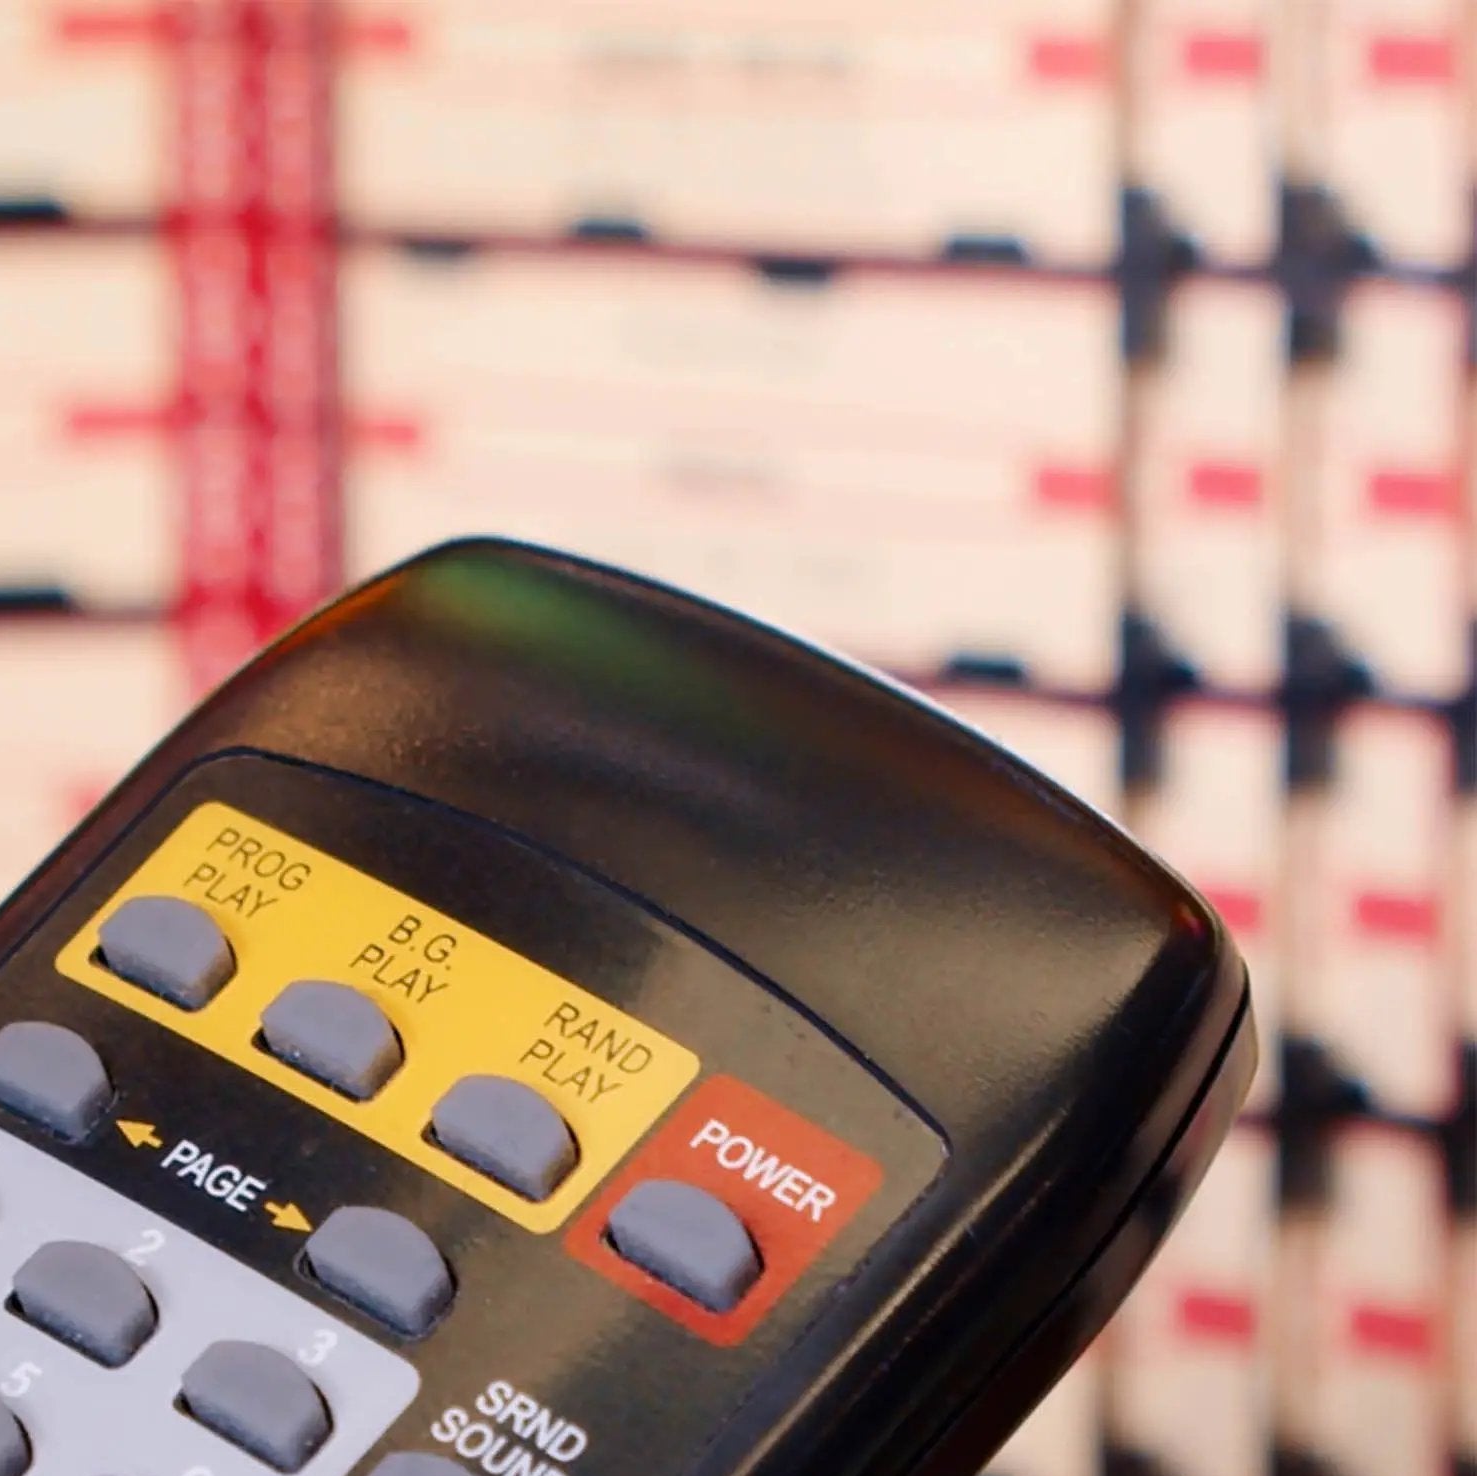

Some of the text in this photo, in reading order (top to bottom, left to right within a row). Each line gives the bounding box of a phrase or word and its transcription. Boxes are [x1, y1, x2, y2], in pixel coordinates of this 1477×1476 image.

[183, 862, 279, 918] PLAY
[205, 826, 312, 892] PROG
[349, 943, 449, 1003] PLAY
[387, 914, 457, 971] B.G.
[543, 1001, 654, 1075] RAND
[519, 1038, 623, 1104] PLAY
[160, 1139, 267, 1212] PAGE
[689, 1118, 837, 1223] POWER
[125, 1227, 166, 1267] 2
[297, 1328, 338, 1367] 3
[0, 1361, 43, 1398] 5
[475, 1379, 588, 1464] SRND
